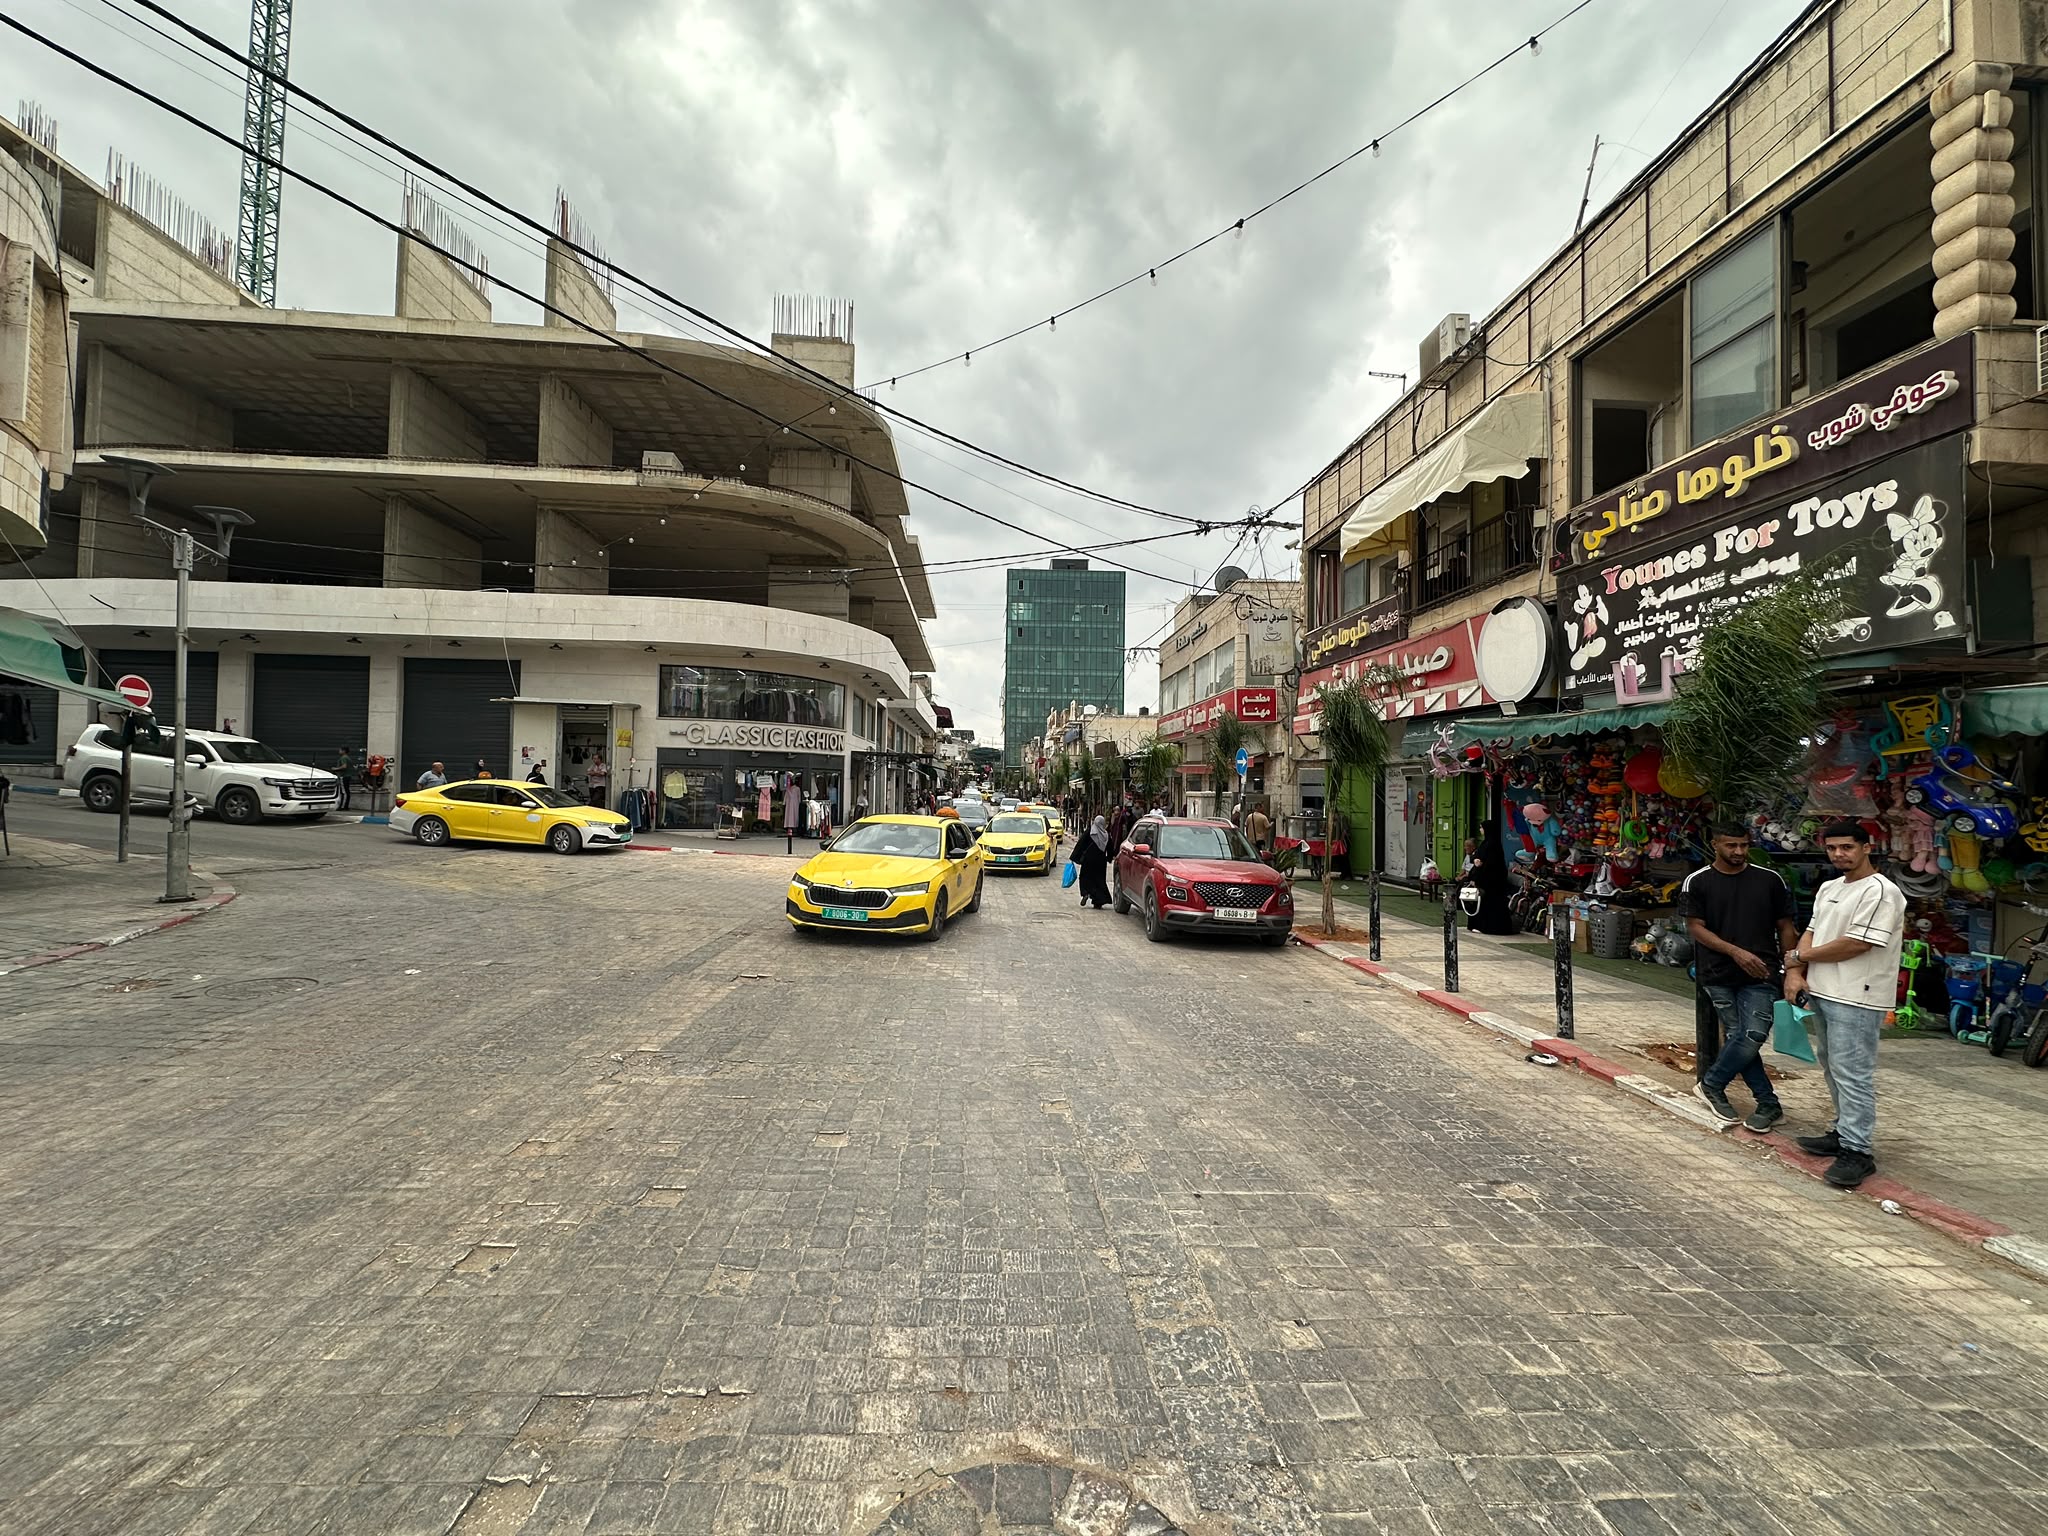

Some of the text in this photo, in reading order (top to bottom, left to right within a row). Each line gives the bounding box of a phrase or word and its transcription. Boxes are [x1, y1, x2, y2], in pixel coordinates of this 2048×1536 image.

[1807, 370, 1958, 450] كوفي شوب
[1676, 424, 1797, 506] خلوها
[1600, 479, 1899, 595] Younes For Toys
[1252, 613, 1289, 624] كوفي شوب
[1338, 616, 1370, 648] خلوها
[757, 676, 790, 688] CLASSIC
[1242, 693, 1271, 705] مطعم
[1242, 707, 1271, 718] مهنا
[685, 723, 846, 751] CLASSIC FASHION
